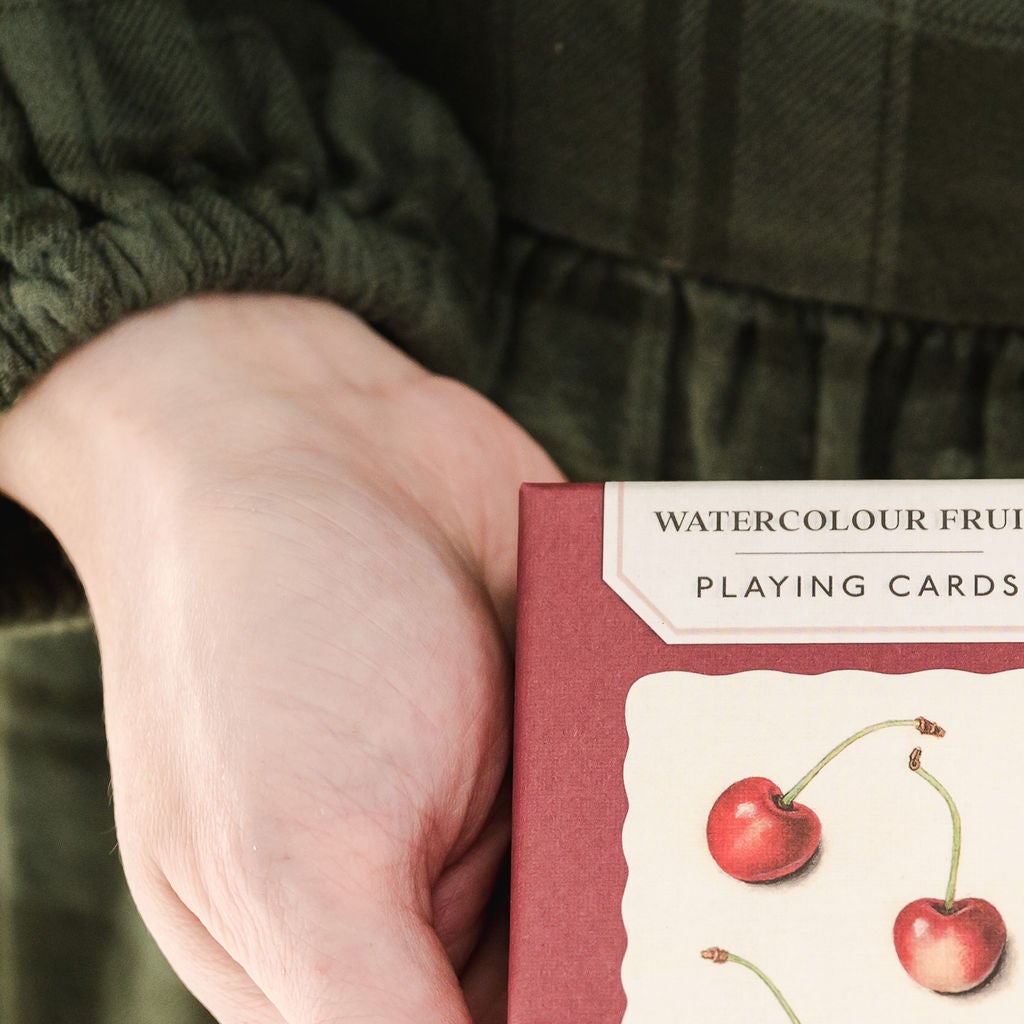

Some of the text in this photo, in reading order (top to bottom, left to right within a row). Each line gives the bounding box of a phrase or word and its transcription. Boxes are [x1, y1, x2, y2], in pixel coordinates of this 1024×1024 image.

[654, 509, 928, 533] WATERCOLOUR
[696, 573, 1019, 598] PLAYING CARDS
